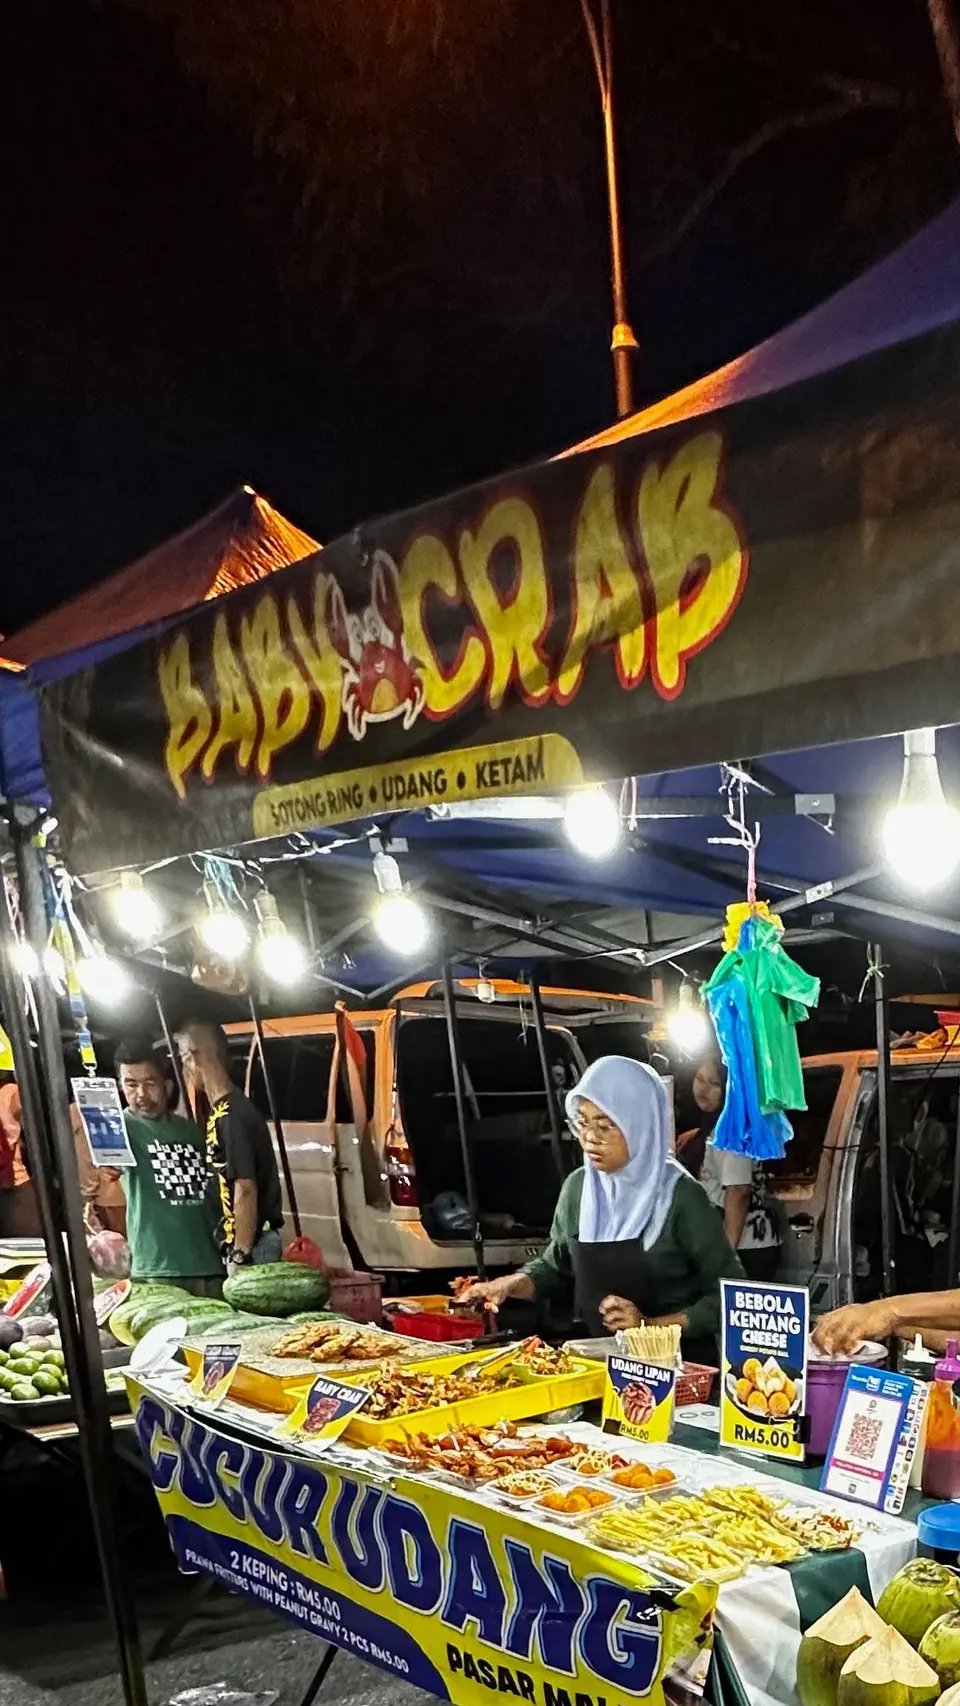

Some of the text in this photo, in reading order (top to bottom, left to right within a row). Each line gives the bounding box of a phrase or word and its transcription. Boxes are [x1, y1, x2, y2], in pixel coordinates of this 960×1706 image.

[157, 430, 748, 806] BABY CRAB
[271, 749, 546, 827] SOTONG RING UDANG KETAM
[729, 1310, 801, 1335] KENTANG
[735, 1291, 795, 1315] BEBOLA
[742, 1329, 787, 1349] CHEESE
[611, 1357, 644, 1377] UDANG
[644, 1363, 671, 1383] LIPAN
[313, 1380, 363, 1405] BABY CRAB
[734, 1423, 790, 1449] RM5.00
[134, 1394, 665, 1697] CUCUR UDANG
[230, 1550, 240, 1570] 2
[242, 1554, 289, 1591] KEPING
[295, 1581, 341, 1621] RM5.00
[250, 1580, 273, 1604] WITH
[274, 1592, 308, 1621] PEANUT
[310, 1611, 341, 1638] GRAVY
[341, 1627, 350, 1642] 2
[349, 1631, 370, 1653] PCS
[369, 1642, 410, 1674] RM5.00
[446, 1642, 537, 1705] PASAR
